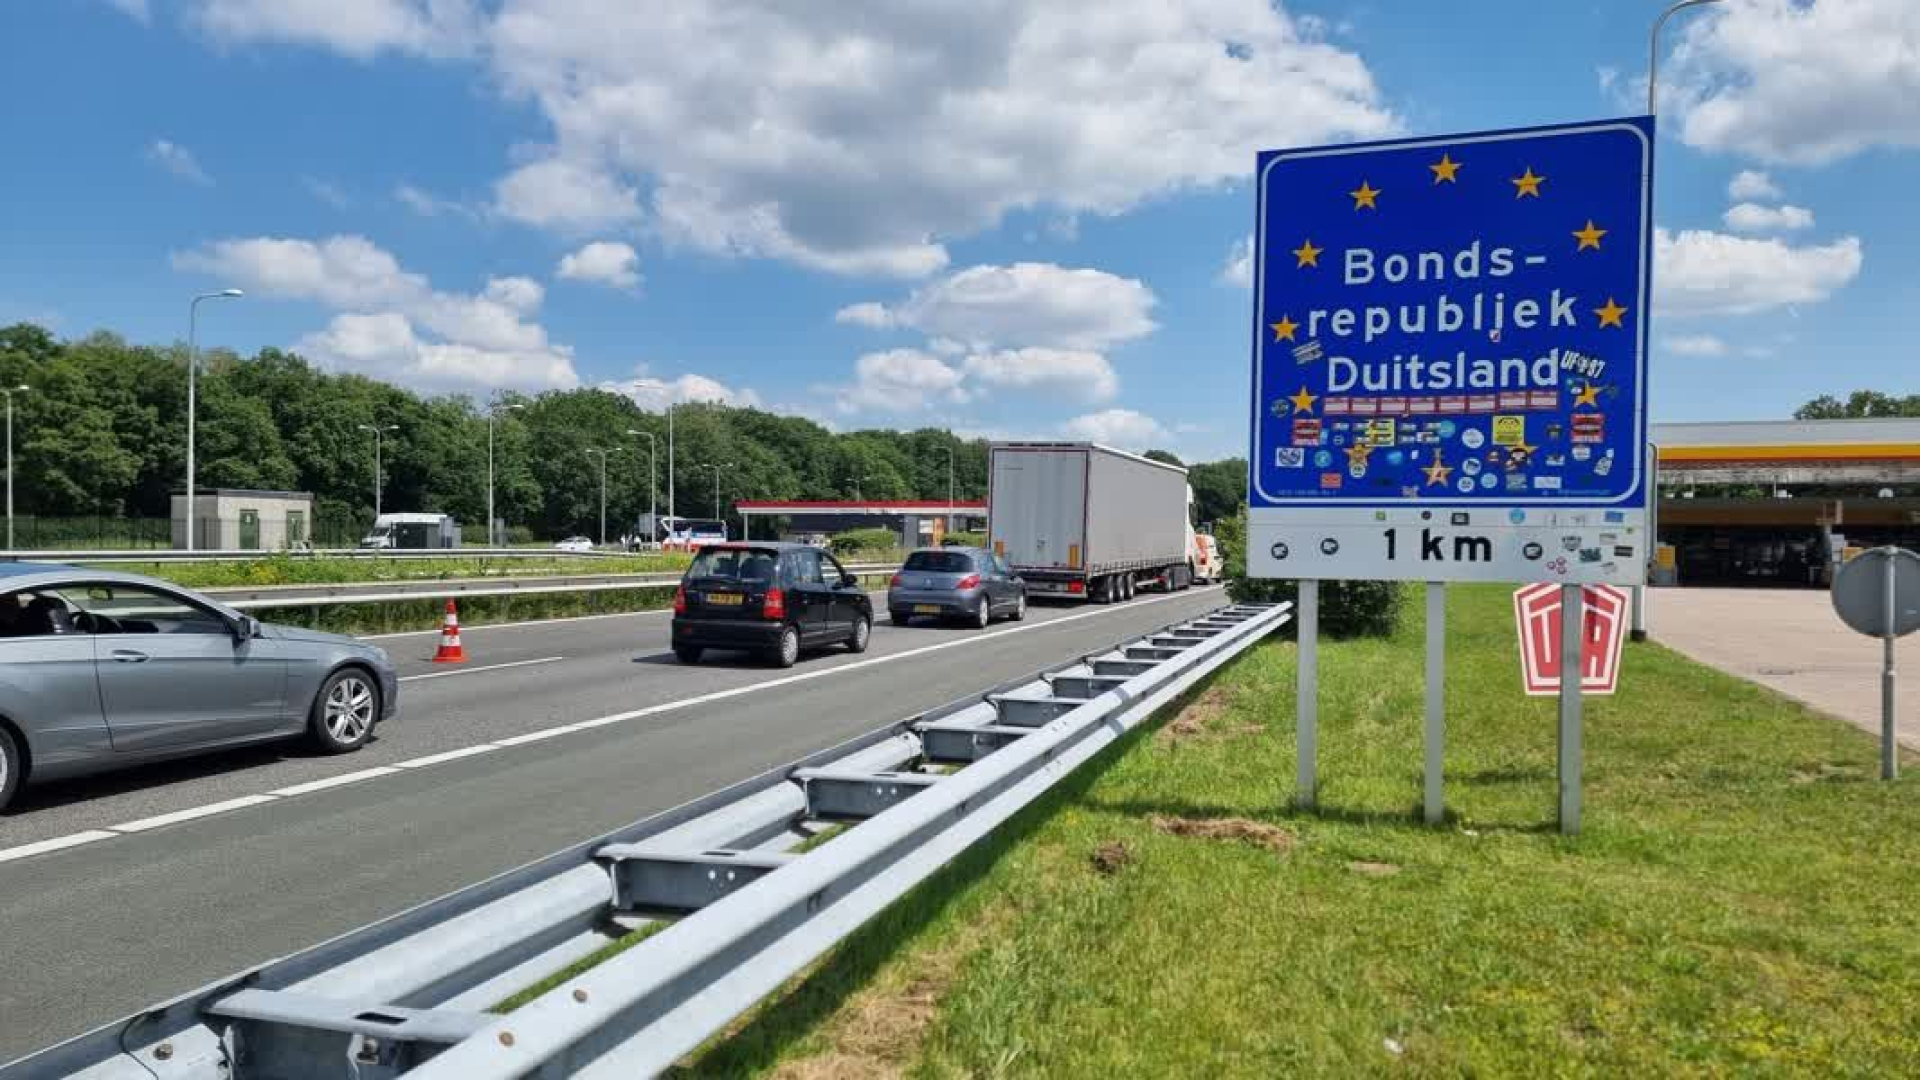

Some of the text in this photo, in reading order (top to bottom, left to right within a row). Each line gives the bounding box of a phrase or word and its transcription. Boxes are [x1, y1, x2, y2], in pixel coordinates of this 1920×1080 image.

[1344, 240, 1547, 285] Bonds-
[1328, 348, 1559, 392] Duitsland
[1384, 527, 1492, 562] 1 km
